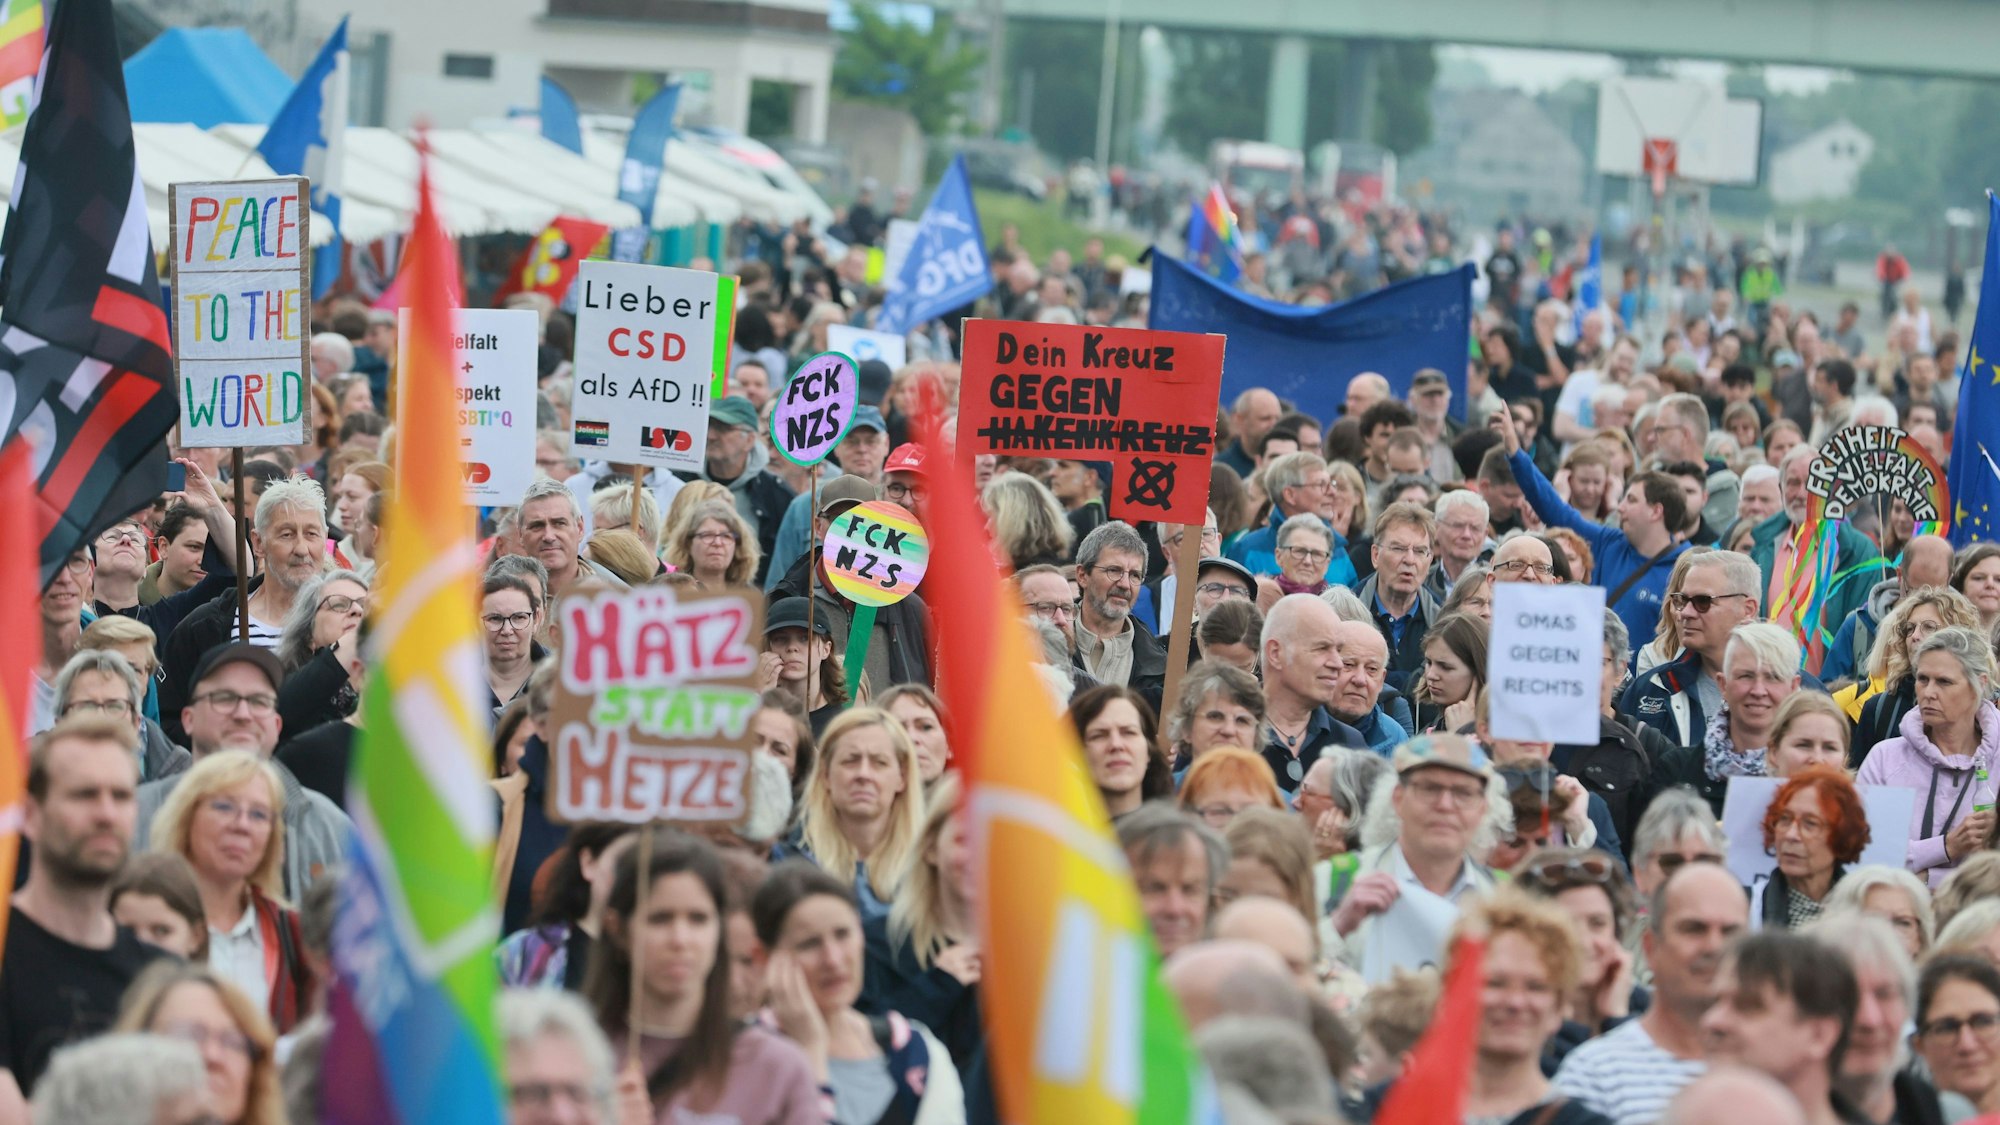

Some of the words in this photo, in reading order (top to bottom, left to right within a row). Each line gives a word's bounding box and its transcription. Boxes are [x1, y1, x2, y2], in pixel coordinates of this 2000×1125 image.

[185, 195, 298, 264] PEACE
[184, 293, 229, 343] TO
[241, 289, 300, 341] THE
[585, 280, 711, 320] Lieber
[450, 333, 498, 350] ielfalt
[607, 327, 686, 362] CSD
[996, 332, 1066, 367] Dein
[1082, 332, 1175, 371] Kreuz
[185, 371, 303, 428] WORLD
[455, 384, 501, 404] spekt
[580, 373, 618, 397] als
[628, 377, 681, 403] AfD
[691, 383, 704, 408] !!
[787, 363, 842, 406] FCK
[990, 373, 1122, 417] GEGEN
[458, 410, 513, 428] SBTIQ
[787, 402, 841, 452] NZS
[986, 414, 1212, 456] HAKENKREUZ
[1806, 426, 1908, 498] FREIHEIT
[1838, 451, 1936, 491] VIELFALT
[1824, 471, 1938, 521] DEMOKRATIE
[846, 514, 908, 556] FCK
[835, 545, 903, 589] NZS
[571, 596, 748, 683] HÄTZ
[1516, 612, 1576, 631] OMAS
[1509, 645, 1580, 664] GEGEN
[1503, 677, 1584, 697] RECHTS
[598, 686, 755, 733] STATT
[568, 730, 738, 811] HETZE
